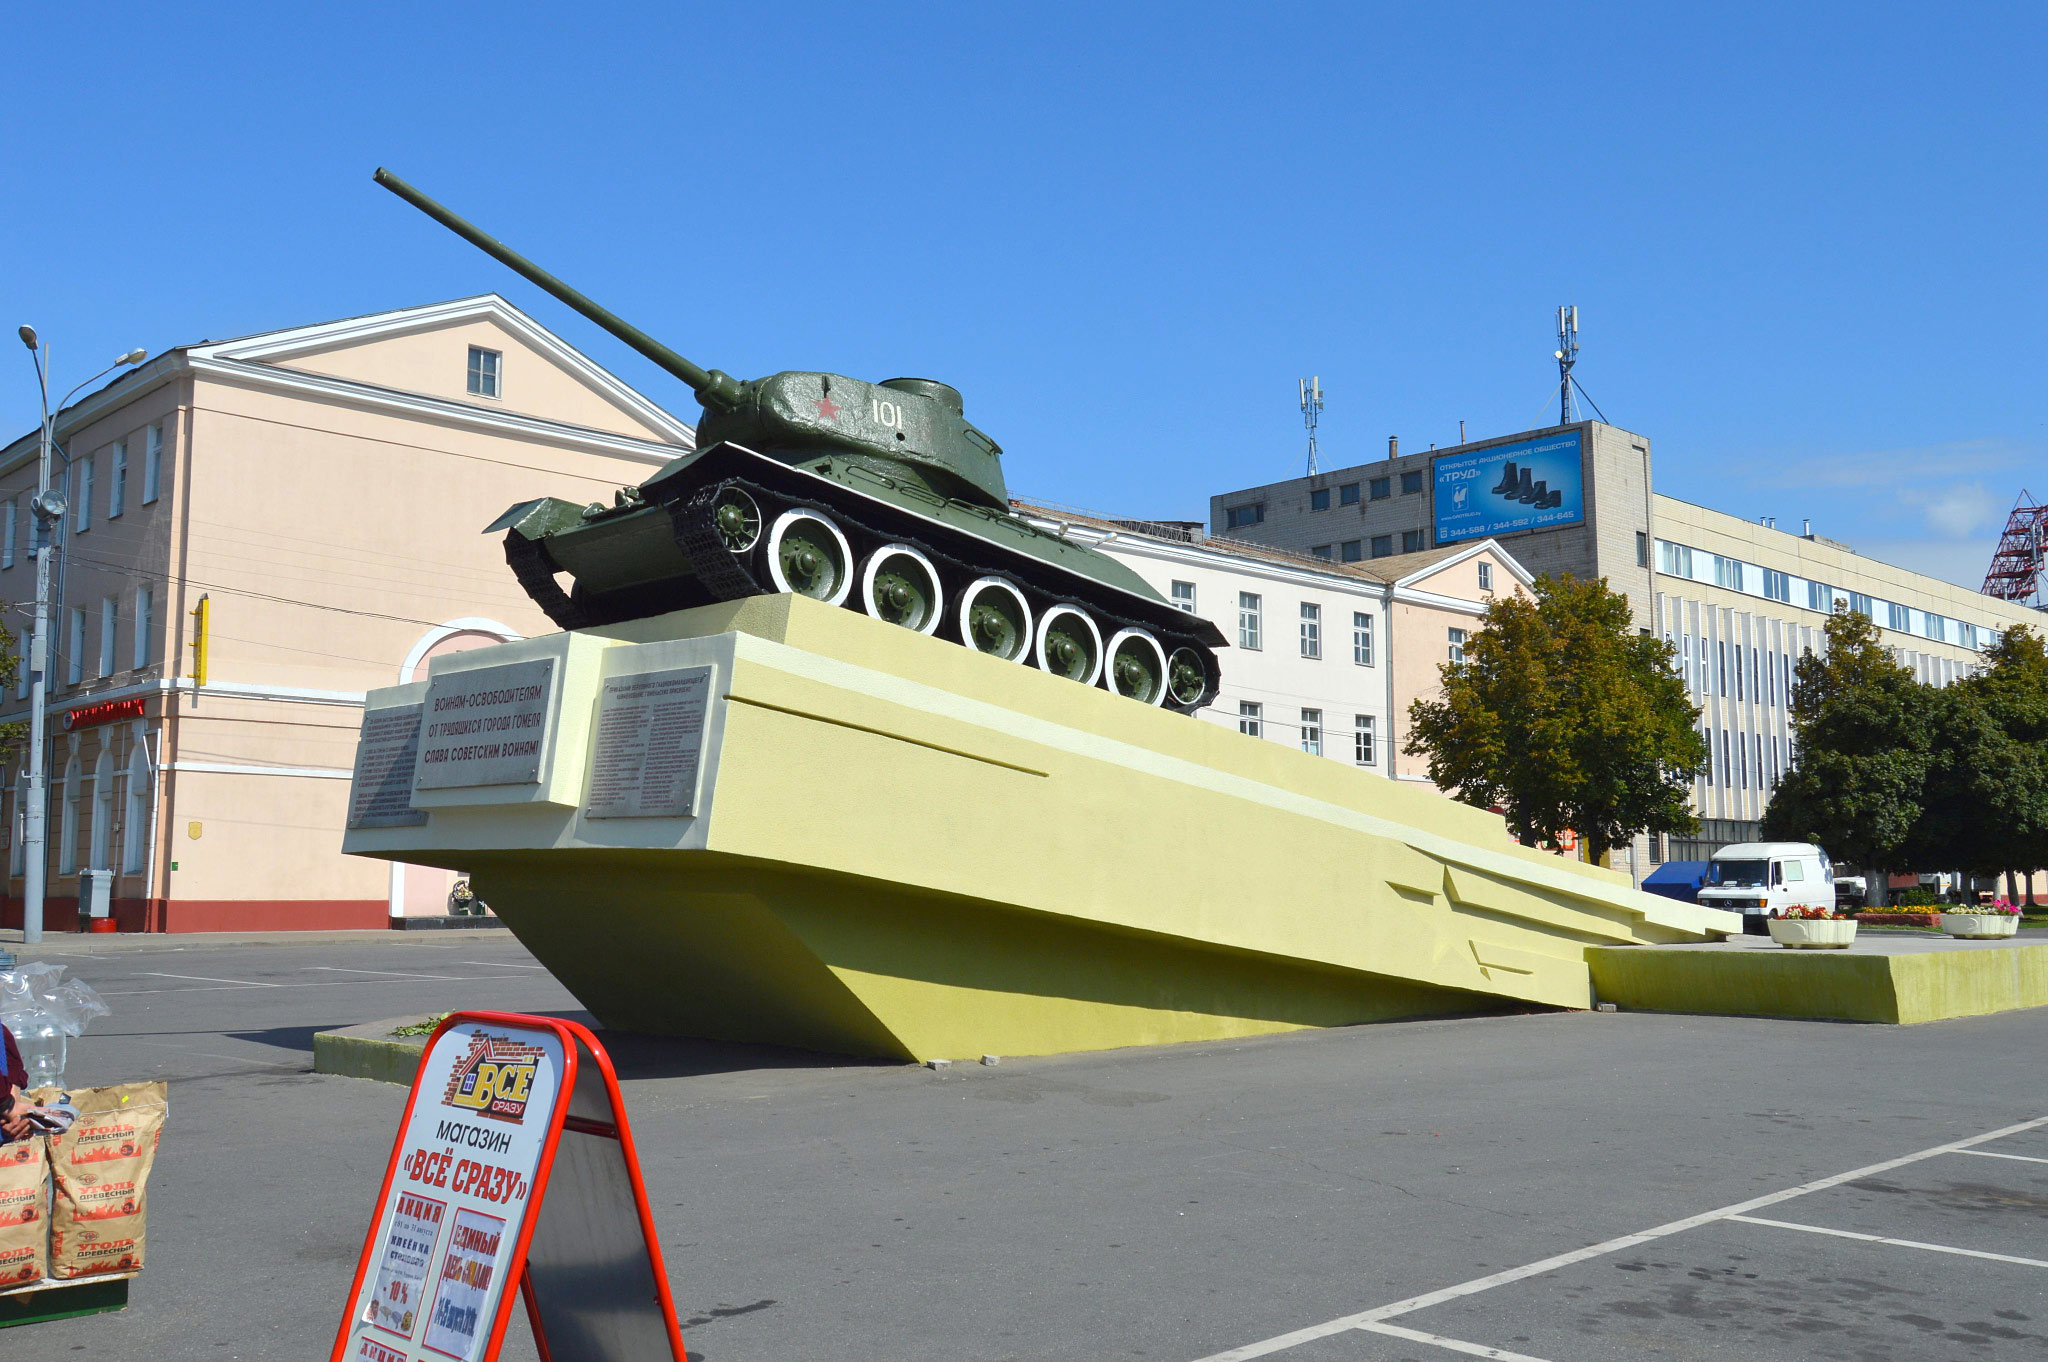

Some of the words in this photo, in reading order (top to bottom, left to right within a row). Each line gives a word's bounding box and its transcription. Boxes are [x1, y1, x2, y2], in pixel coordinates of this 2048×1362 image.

[872, 399, 902, 429] 101
[1440, 459, 1477, 472] ОТКРЫТОЕ
[1478, 449, 1533, 464] АКЦИОНЕРНОЕ
[1533, 440, 1577, 454] ОБЩЕСТВО
[1439, 468, 1482, 483] «ТРУД»
[434, 685, 542, 712] ВОИНАМ-ОСВОБОДИТЕЛЯМ
[428, 723, 438, 737] ОТ
[439, 719, 481, 737] ТРУДЯЩИХСЯ
[483, 715, 510, 733] ГОРОДА
[512, 712, 541, 728] ГОМЕЛЯ
[424, 747, 448, 764] СЛАВА
[450, 744, 500, 761] СОВЕТСКИМ
[502, 740, 539, 758] ВОИНАМ!
[491, 1100, 524, 1115] СРАЗУ
[76, 1123, 135, 1137] УГОЛЬ
[78, 1130, 135, 1143] ДРЕВЕСНЫЙ
[404, 1147, 454, 1188] «ВСЁ
[452, 1158, 527, 1205] СРАЗУ»
[0, 1187, 36, 1199] ОЛЬ
[77, 1180, 135, 1194] УГОЛЬ
[79, 1188, 135, 1201] ДРЕВЕСНЫЙ
[396, 1196, 442, 1224] АКЦИЯ
[77, 1237, 135, 1251] УГОЛЬ
[453, 1224, 501, 1257] ЕДИНЫЙ
[0, 1247, 36, 1259] ОЛЬ
[76, 1243, 135, 1258] ДРЕВЕСНЫЙ
